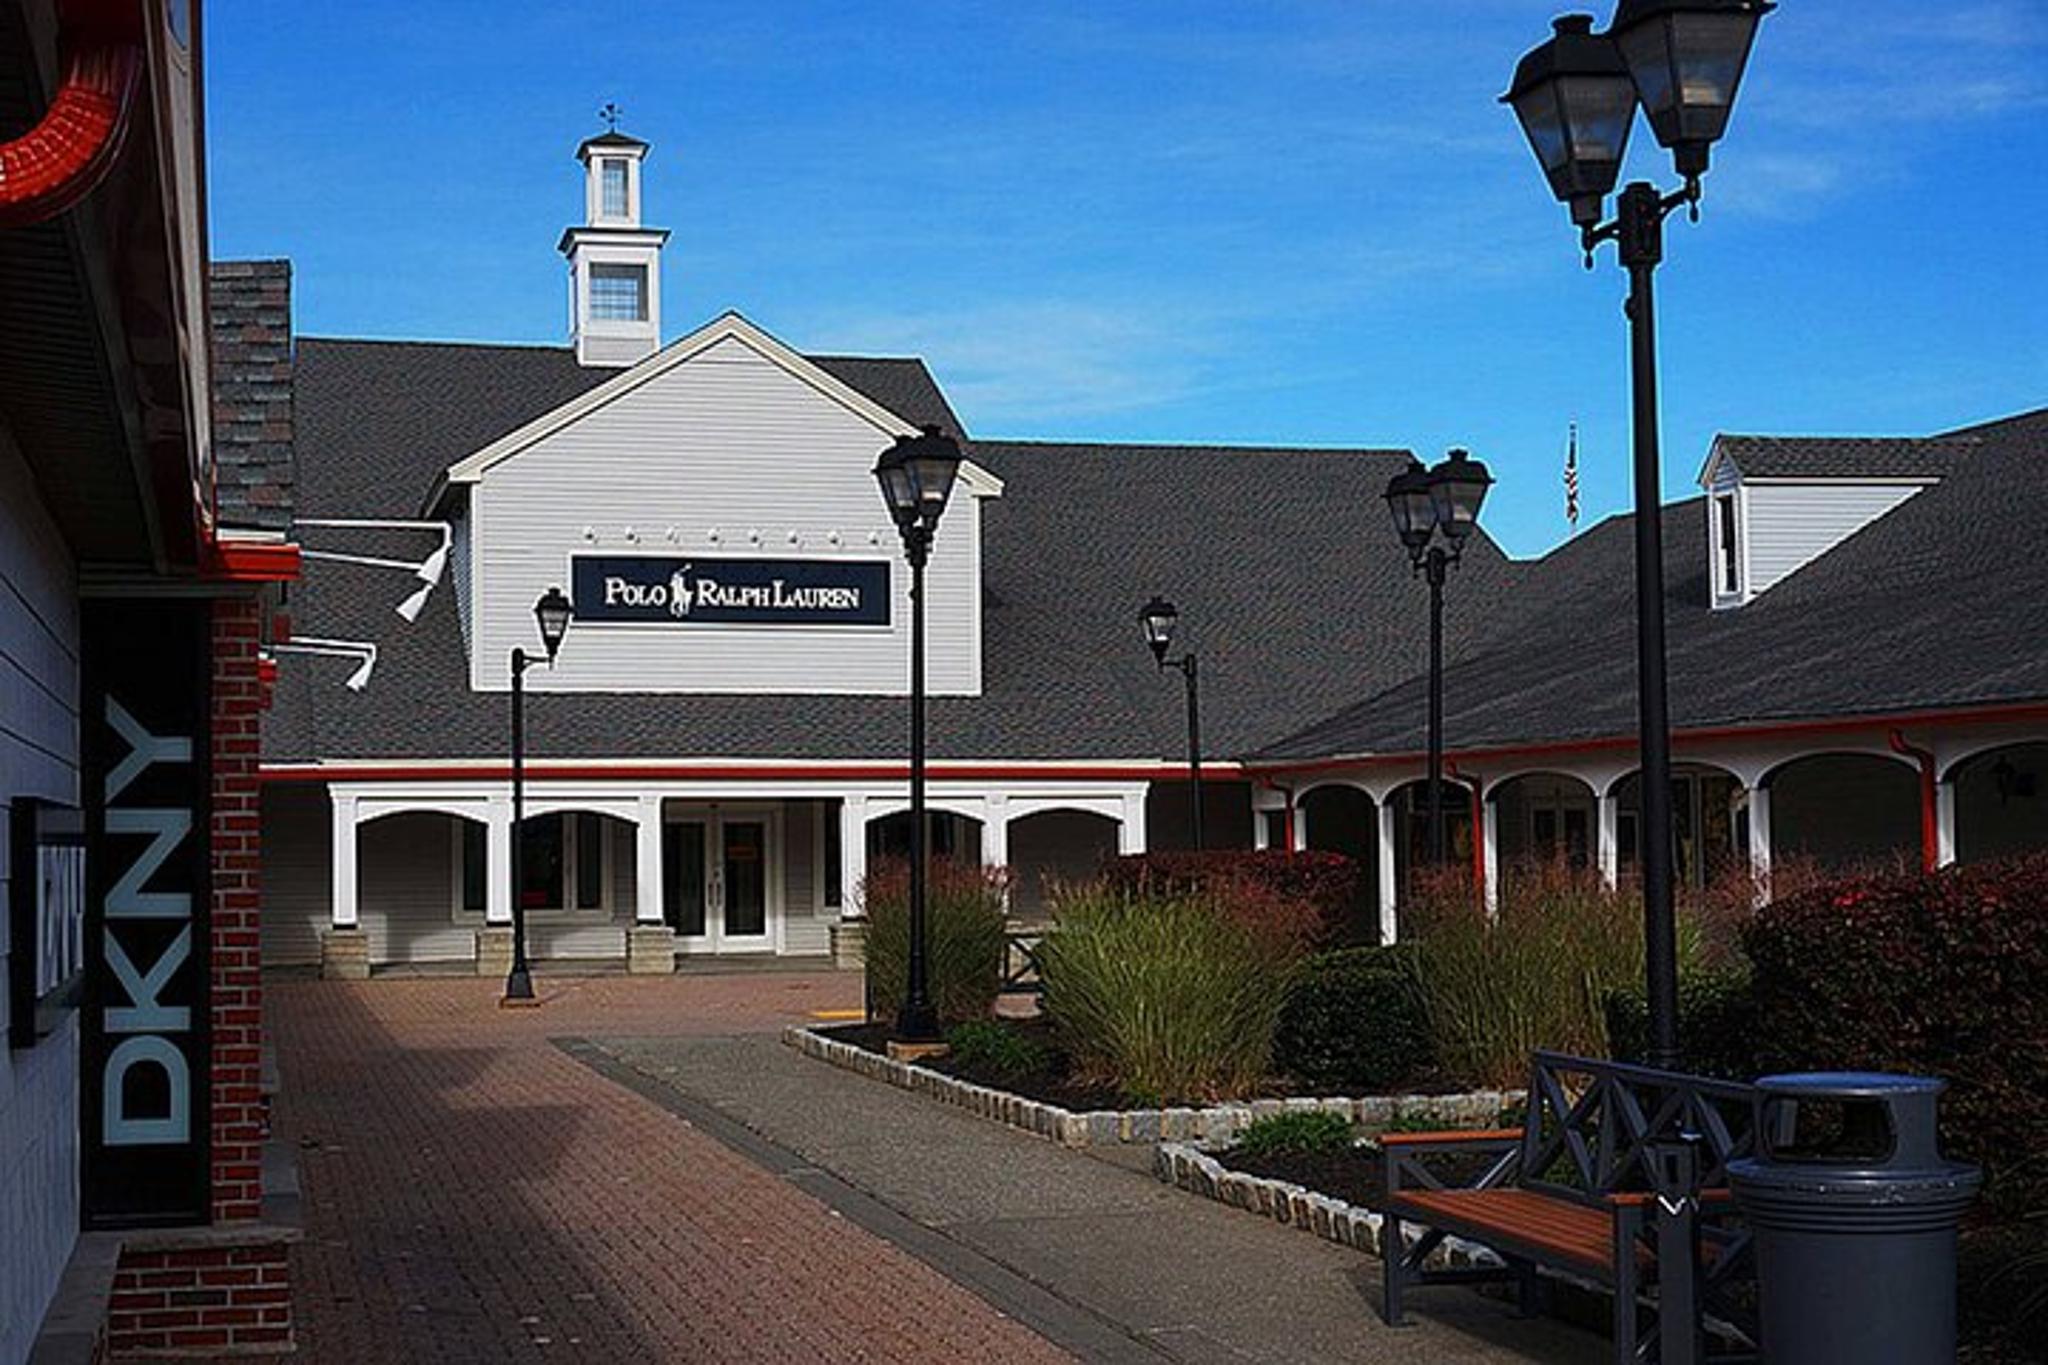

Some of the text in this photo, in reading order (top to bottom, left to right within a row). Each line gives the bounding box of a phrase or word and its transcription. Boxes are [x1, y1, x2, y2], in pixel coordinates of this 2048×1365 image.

[605, 577, 860, 609] POLO RALPH LAUREN
[103, 693, 192, 1144] DKNY
